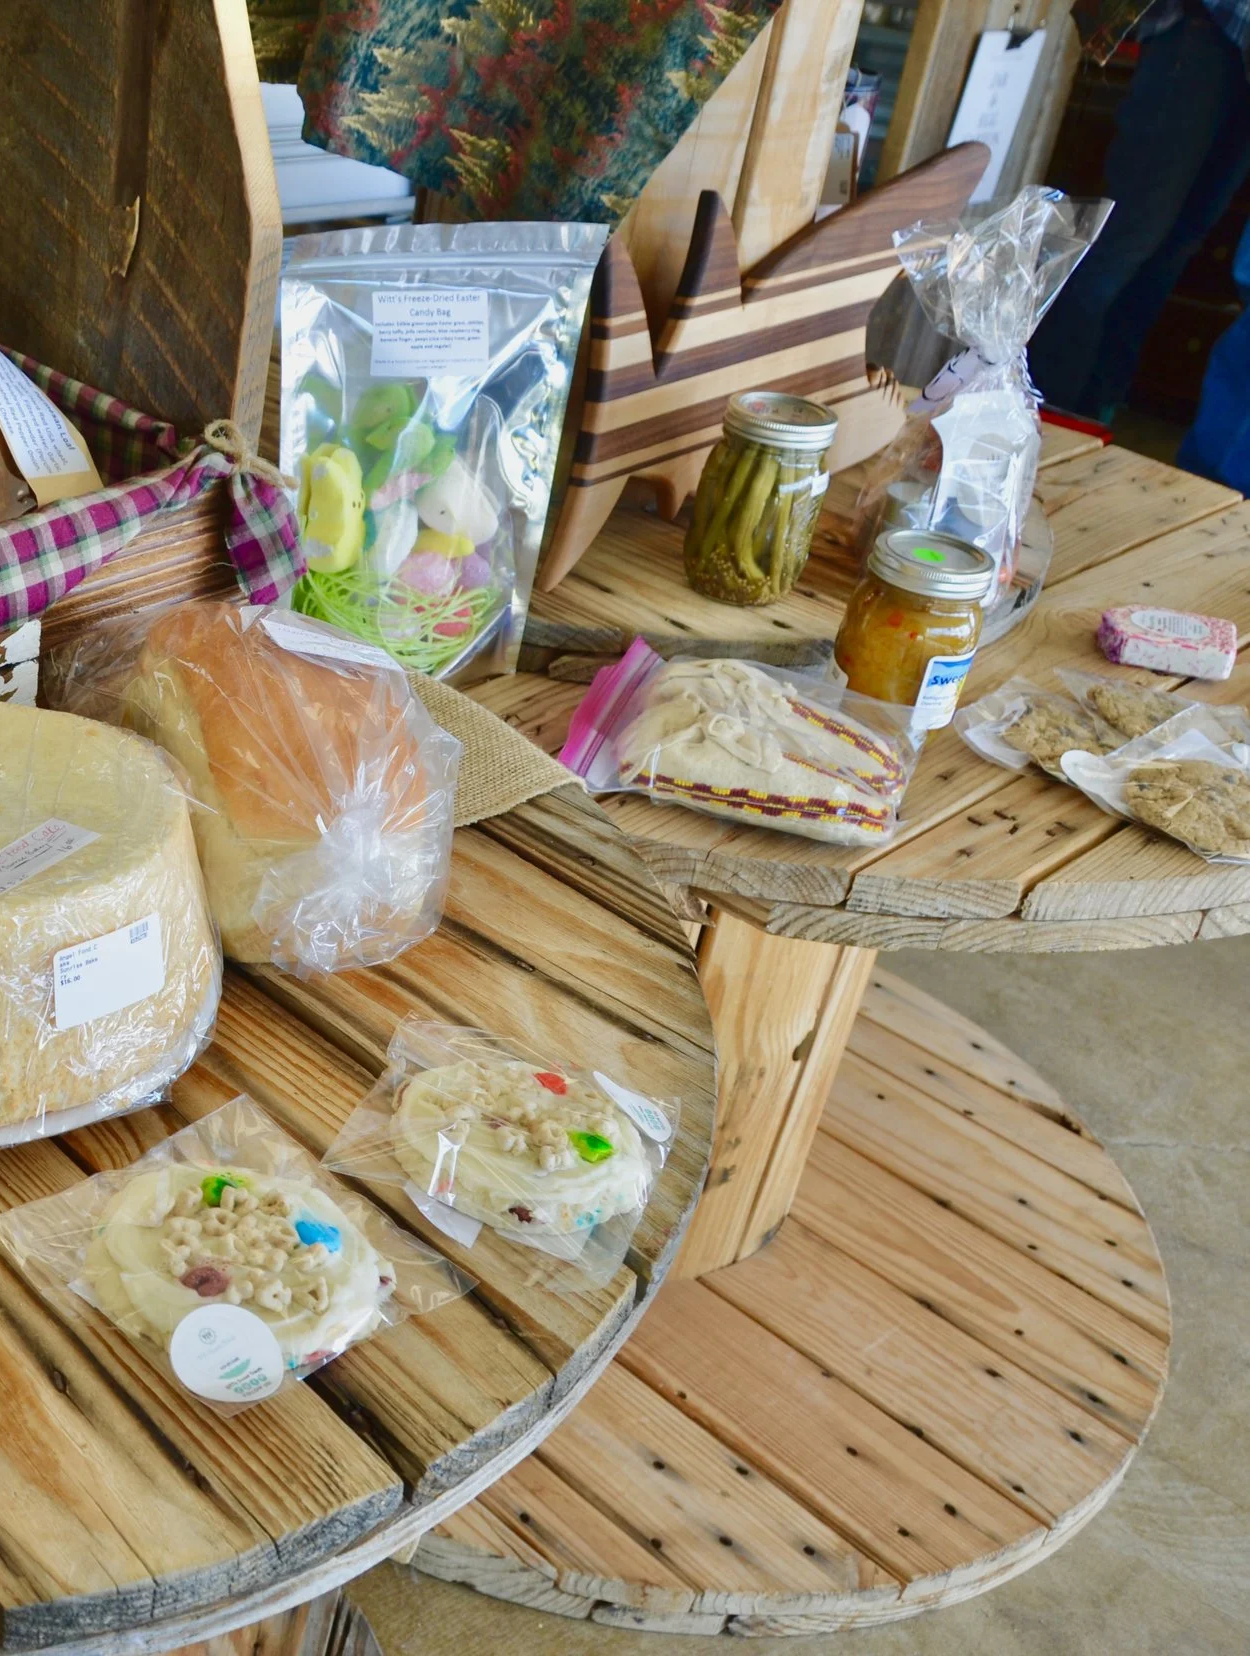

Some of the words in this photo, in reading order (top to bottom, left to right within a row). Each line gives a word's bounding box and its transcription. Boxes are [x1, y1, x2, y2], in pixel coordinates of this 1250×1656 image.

[378, 295, 401, 303] Witt's
[410, 308, 435, 317] Candy
[437, 308, 451, 316] Bag
[60, 432, 76, 450] Loaf
[60, 975, 80, 986] $16.00
